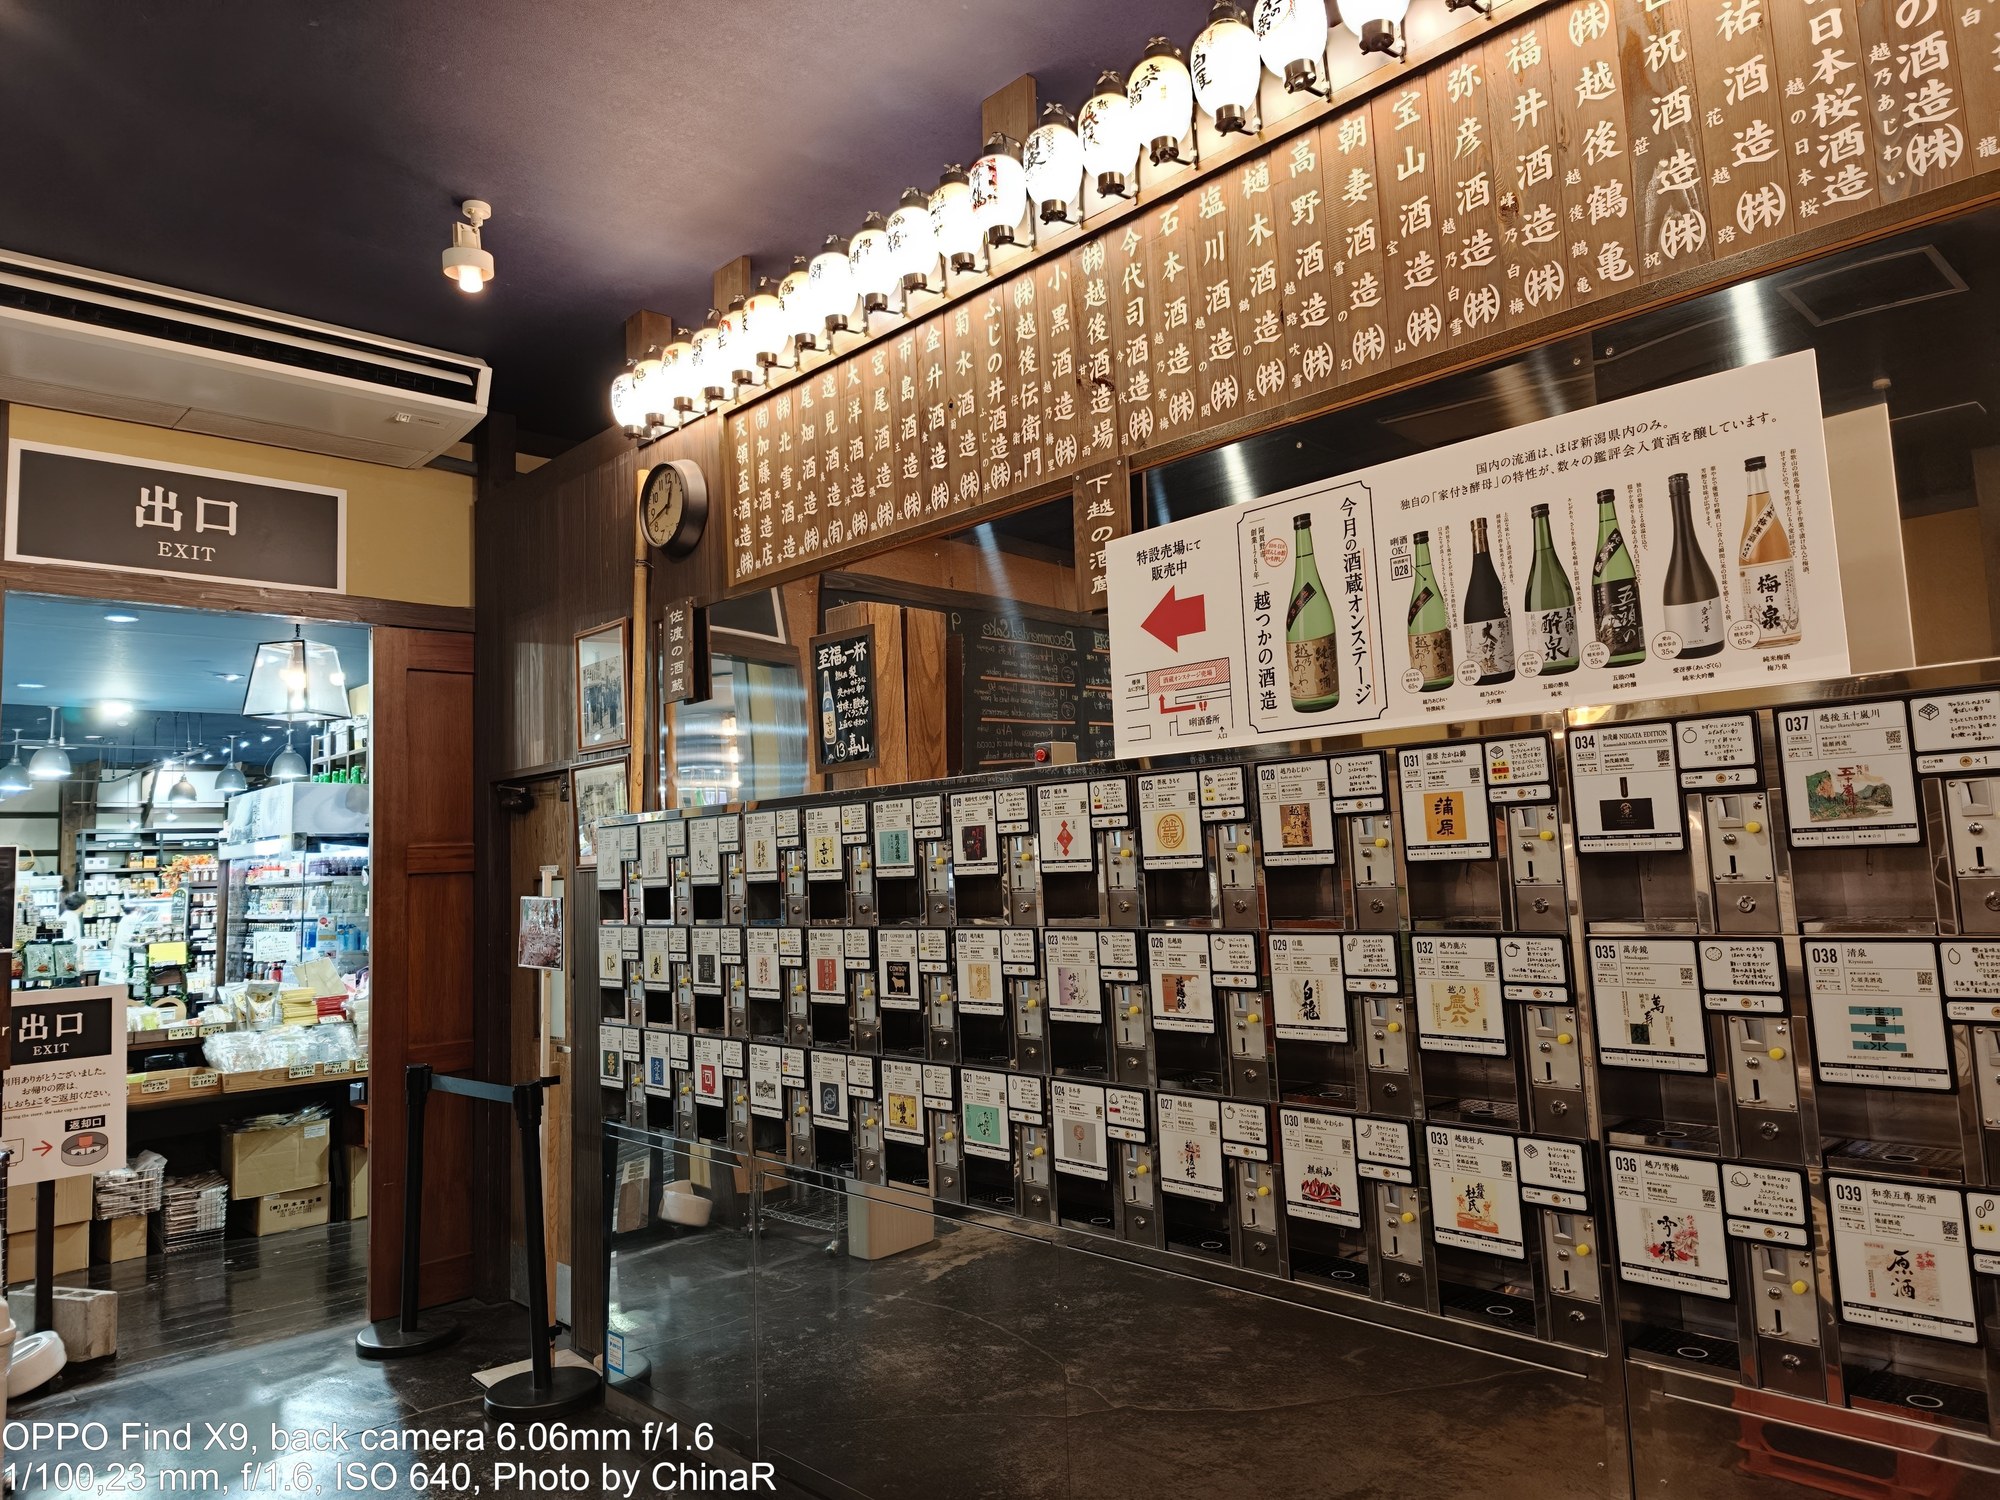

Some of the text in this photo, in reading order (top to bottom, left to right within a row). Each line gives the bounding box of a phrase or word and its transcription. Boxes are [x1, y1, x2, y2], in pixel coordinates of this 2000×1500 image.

[1868, 42, 1907, 186] 越乃あじわい
[1784, 78, 1819, 219] 越の日本桜
[1386, 240, 1407, 354] 宝山
[1476, 420, 1669, 476] 国内の流通は、ほぼ新潟県内のみ。
[136, 485, 238, 536] 出口
[157, 541, 216, 562] EXIT
[1136, 539, 1201, 566] 特設売場にて
[1151, 560, 1187, 581] 販売中
[1394, 565, 1409, 577] 028
[1340, 496, 1372, 705] 今月の酒蔵オンステージ
[669, 610, 684, 693] 佐渡の酒蔵
[818, 641, 867, 670] 至福の一杯
[1253, 590, 1277, 711] 越つかの酒造
[1762, 654, 1791, 663] 純米梅酒
[1163, 669, 1213, 684] 酒蔵オンステージ売場
[1819, 709, 1880, 722] 越後五十嵐川
[1785, 716, 1809, 732] 037
[1644, 730, 1667, 738] EDITION
[1575, 735, 1595, 750] 034
[1404, 754, 1419, 767] 031
[1260, 768, 1275, 782] 028
[1141, 780, 1154, 791] 025
[1039, 789, 1051, 799] 022
[952, 797, 962, 807] 019
[1434, 796, 1455, 836] 蒲原
[958, 933, 968, 943] 020
[1047, 935, 1059, 946] 023
[1151, 937, 1164, 949] 026
[1272, 938, 1288, 951] 029
[1416, 941, 1433, 954] 032
[1595, 945, 1616, 959] 035
[1623, 945, 1648, 954] 萬寿鏡
[1847, 948, 1867, 958] 清泉
[1812, 948, 1838, 963] 038
[18, 1012, 84, 1043] 出口
[33, 1043, 70, 1056] EXIT
[963, 1072, 972, 1083] 021
[22, 1082, 78, 1095] お帰りの際は、
[1054, 1085, 1065, 1096] 024
[1160, 1097, 1173, 1110] 027
[69, 1118, 101, 1130] 返却口
[1283, 1113, 1299, 1127] 030
[1431, 1131, 1448, 1145] 033
[1455, 1134, 1484, 1145] 越後杜氏
[1615, 1156, 1637, 1172] 036
[1645, 1159, 1680, 1172] 越乃雪椿
[1836, 1184, 1862, 1201] 039
[1871, 1188, 1937, 1204] 和楽互尊 原酒
[1887, 1250, 1915, 1300] 原酒
